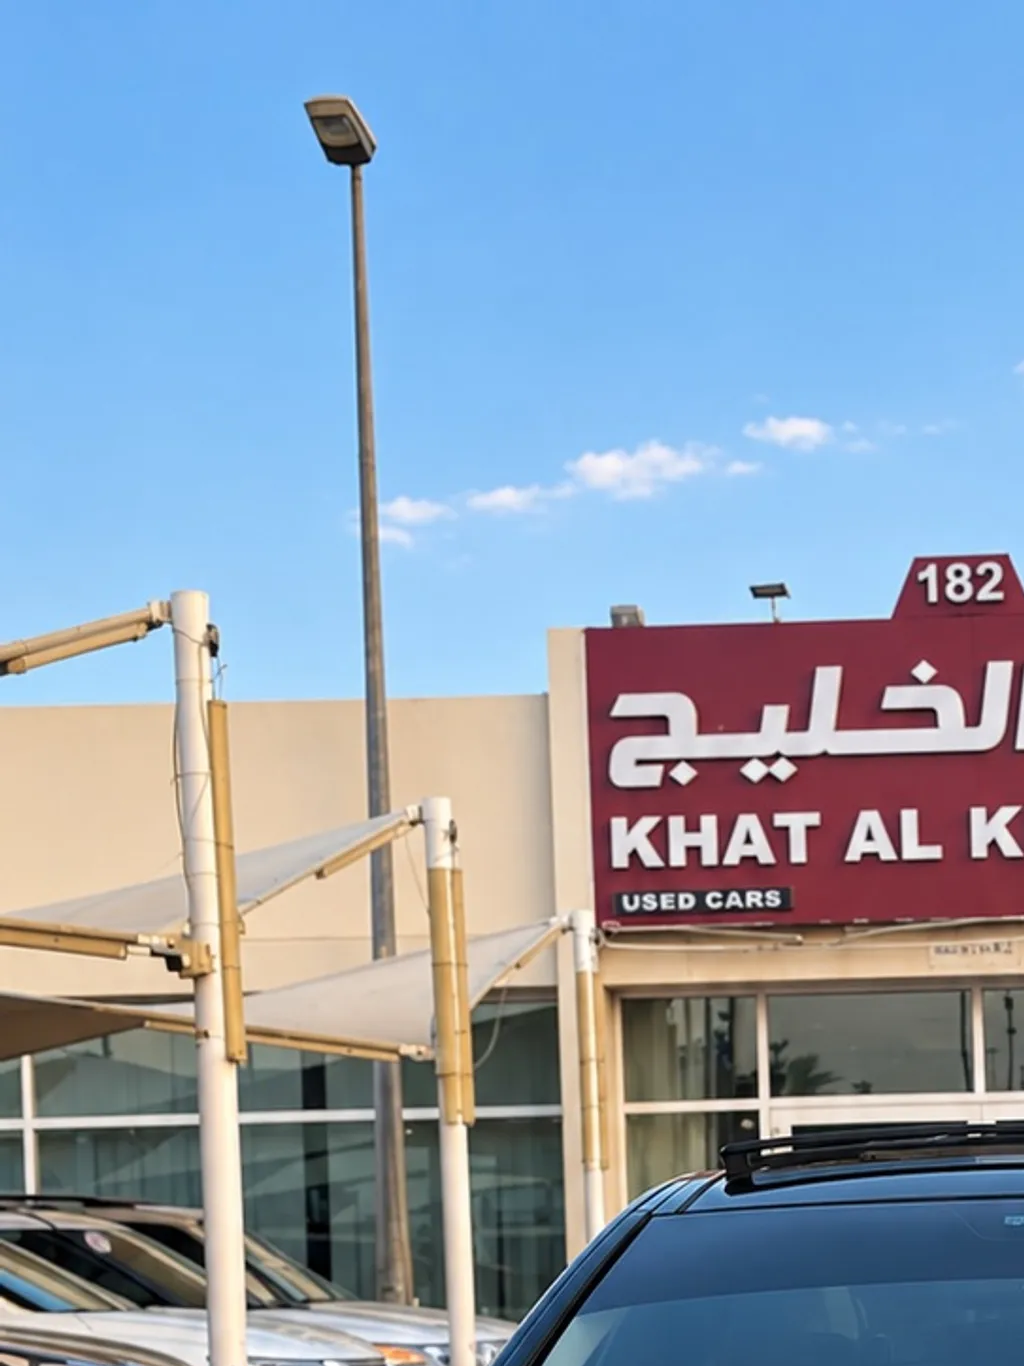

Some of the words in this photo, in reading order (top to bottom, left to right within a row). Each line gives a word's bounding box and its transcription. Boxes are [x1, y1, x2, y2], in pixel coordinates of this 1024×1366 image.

[917, 561, 1005, 604] 182
[610, 811, 821, 869] KHAT
[844, 808, 943, 863] AL
[621, 892, 696, 912] USED
[704, 889, 782, 909] CARS
